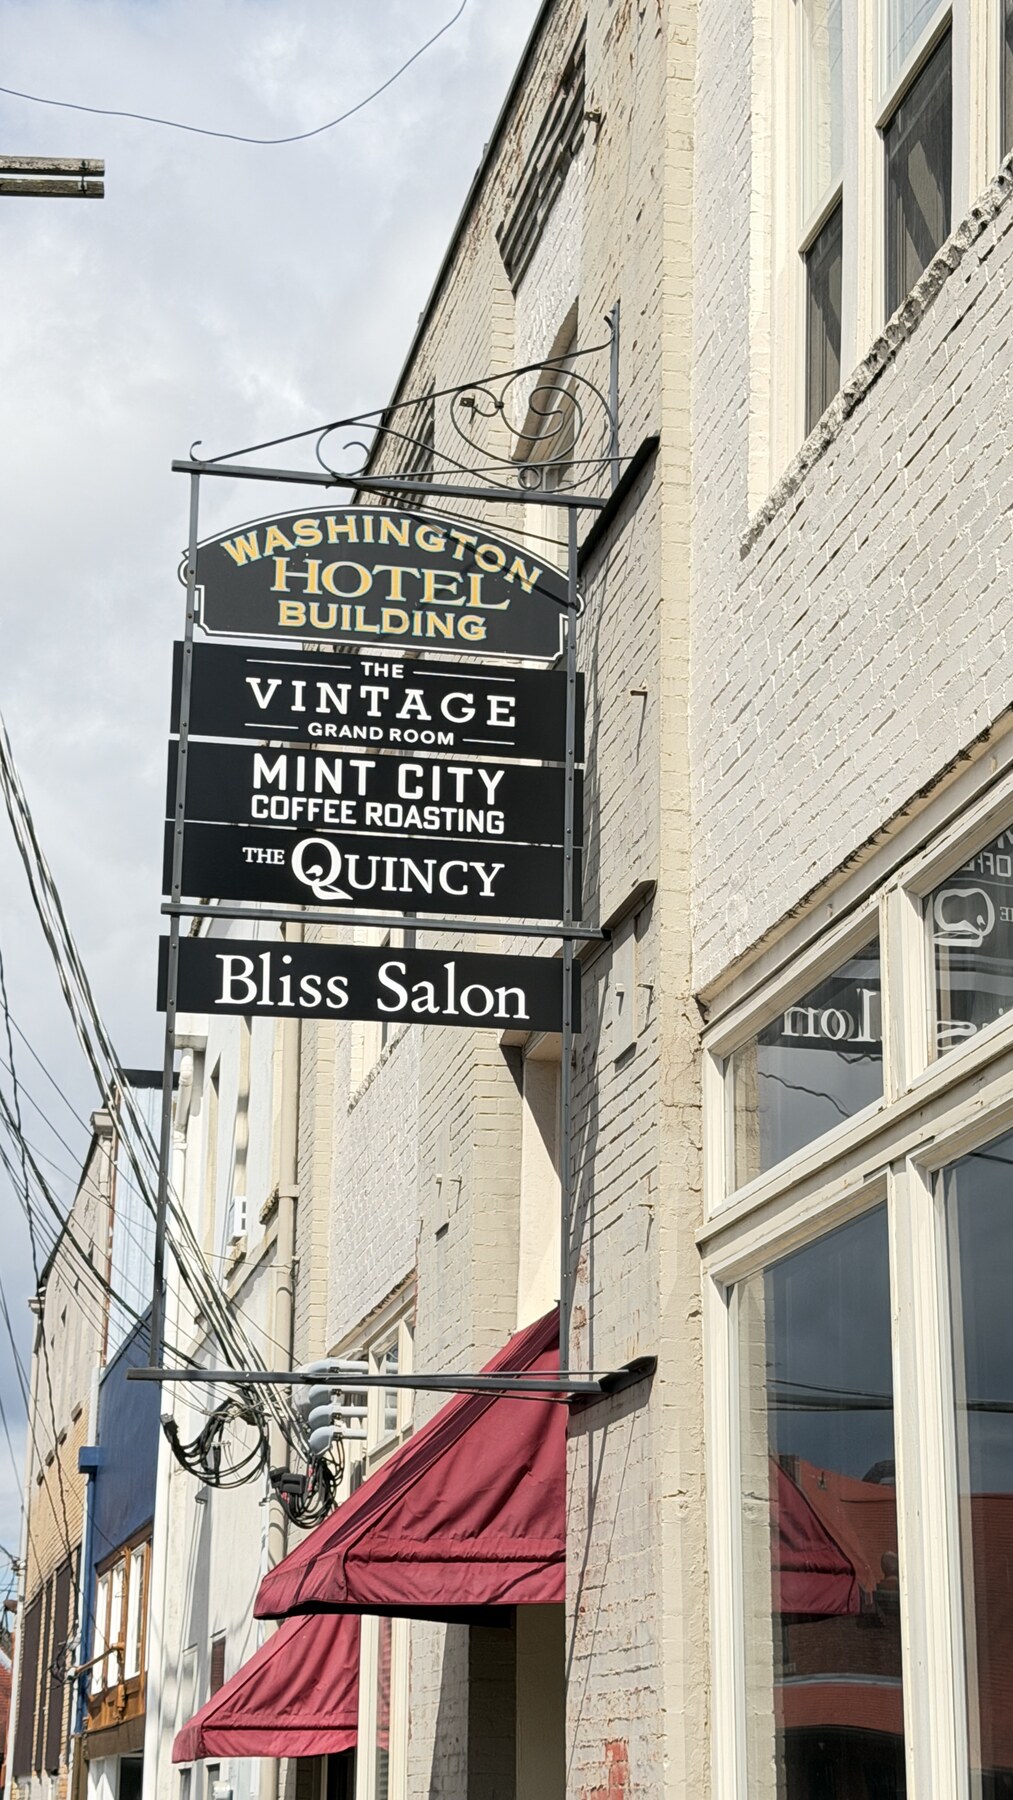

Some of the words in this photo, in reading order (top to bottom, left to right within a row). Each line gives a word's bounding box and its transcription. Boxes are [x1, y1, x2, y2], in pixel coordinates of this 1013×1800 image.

[221, 515, 543, 594] WASHINGTON
[270, 556, 511, 611] HOTEL
[278, 601, 488, 641] BUILDING
[360, 662, 405, 679] THE
[246, 677, 516, 728] VINTAGE
[308, 722, 384, 741] GRAND
[390, 728, 455, 746] ROOM
[253, 753, 376, 796] MINT
[398, 763, 505, 806] CITY
[251, 795, 357, 825] COFFEE
[366, 802, 505, 835] ROASTING
[242, 847, 285, 865] THE
[291, 837, 505, 900] QUINCY
[215, 951, 349, 1008] Bliss
[377, 961, 530, 1020] Salon
